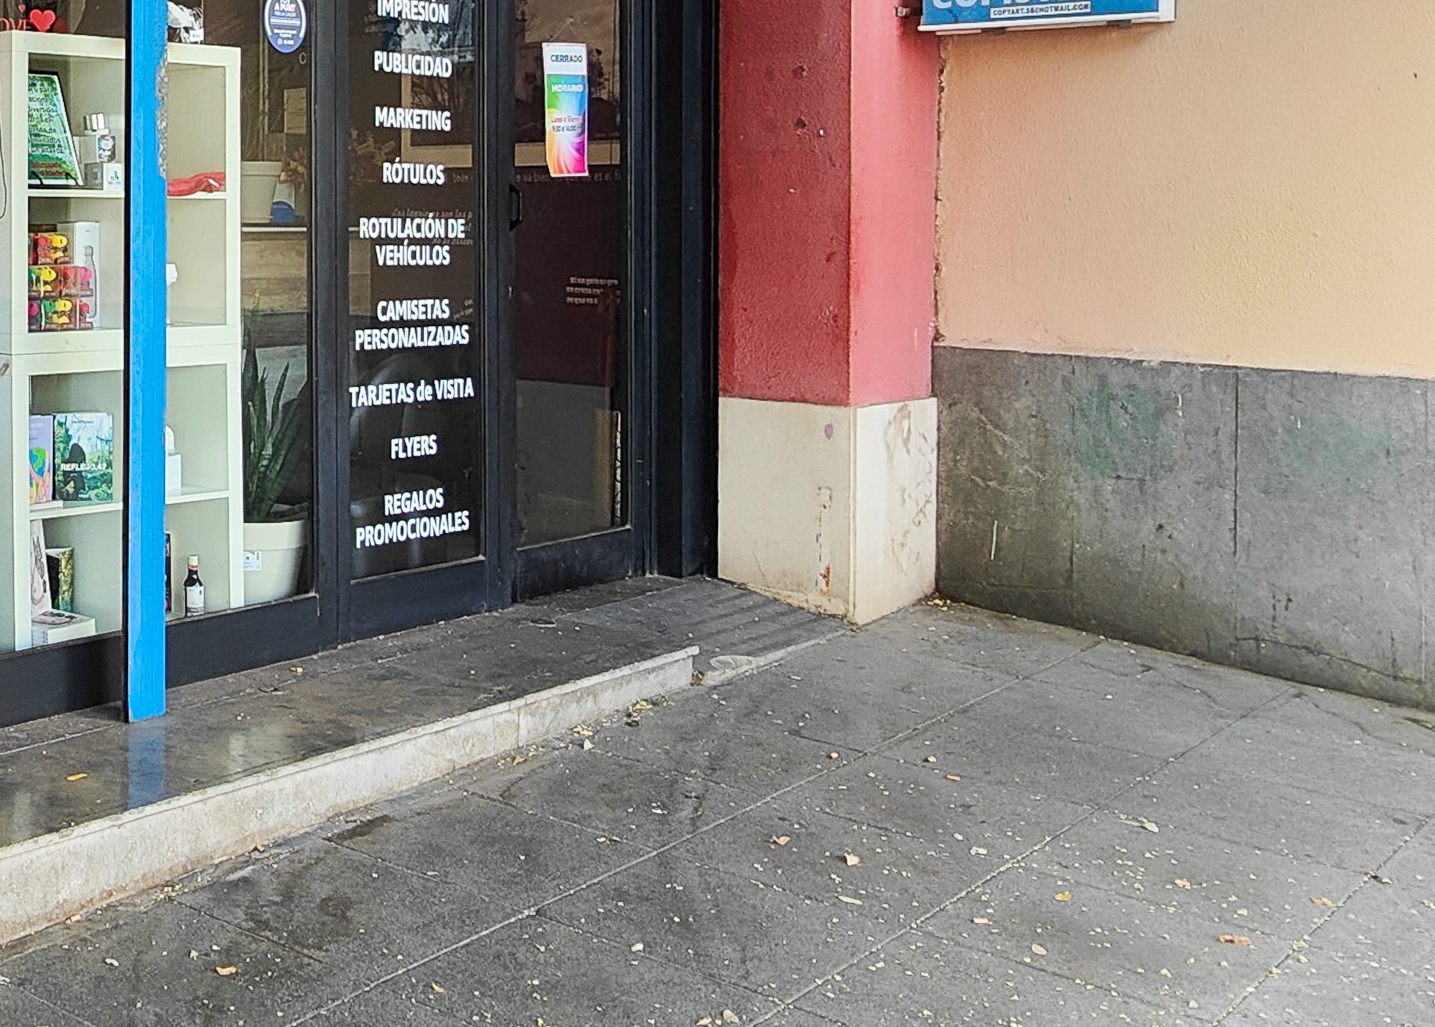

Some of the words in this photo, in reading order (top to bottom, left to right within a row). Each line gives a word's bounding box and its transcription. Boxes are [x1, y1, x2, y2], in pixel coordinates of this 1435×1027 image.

[374, 51, 452, 78] PUBLICIDAD
[550, 54, 583, 63] CERRADO
[551, 83, 584, 92] HORARIO
[375, 106, 451, 131] MARKETING
[383, 157, 445, 185] RÓTULOS
[359, 213, 446, 238] ROTULACIÓN
[448, 219, 465, 238] DE
[376, 240, 450, 266] VEHÍCULOS
[377, 299, 450, 322] CAMISETAS
[355, 325, 469, 350] PERSONALIZADAS
[349, 382, 414, 407] TARJETAS
[416, 380, 432, 401] de
[434, 377, 474, 400] VISITA
[391, 434, 437, 459] FLYERS
[384, 488, 444, 516] REGALOS
[355, 510, 469, 548] PROMOCIONALES
